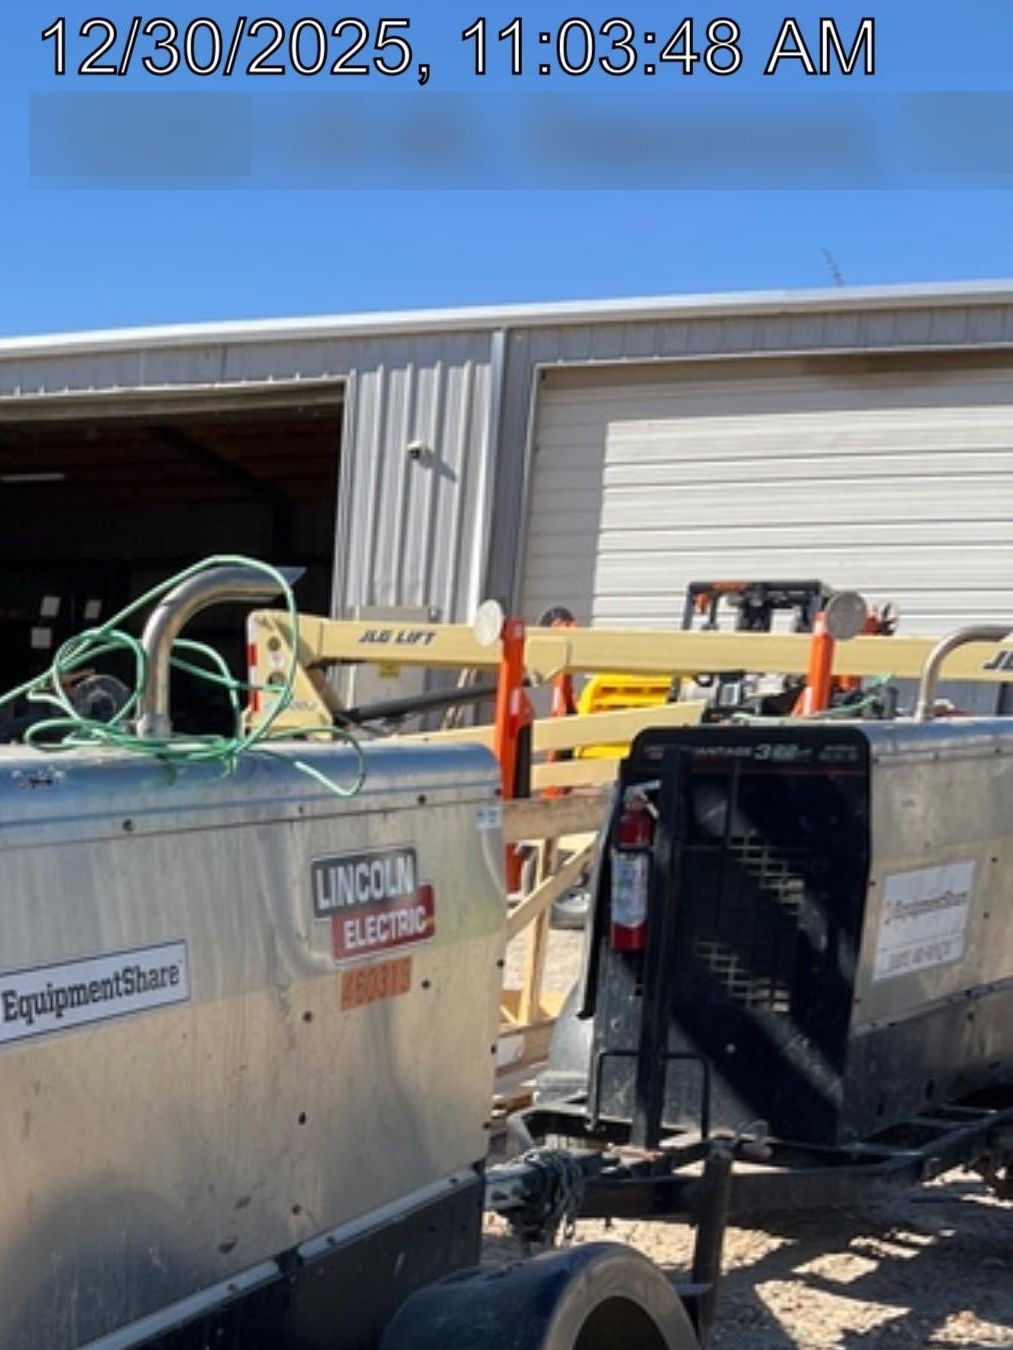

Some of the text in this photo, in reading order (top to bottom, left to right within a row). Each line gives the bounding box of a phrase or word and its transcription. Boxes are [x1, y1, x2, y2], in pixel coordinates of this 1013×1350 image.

[315, 856, 414, 910] LINCOLN
[343, 905, 427, 949] ELECTRIC
[2, 963, 180, 1025] EquipmentShare
